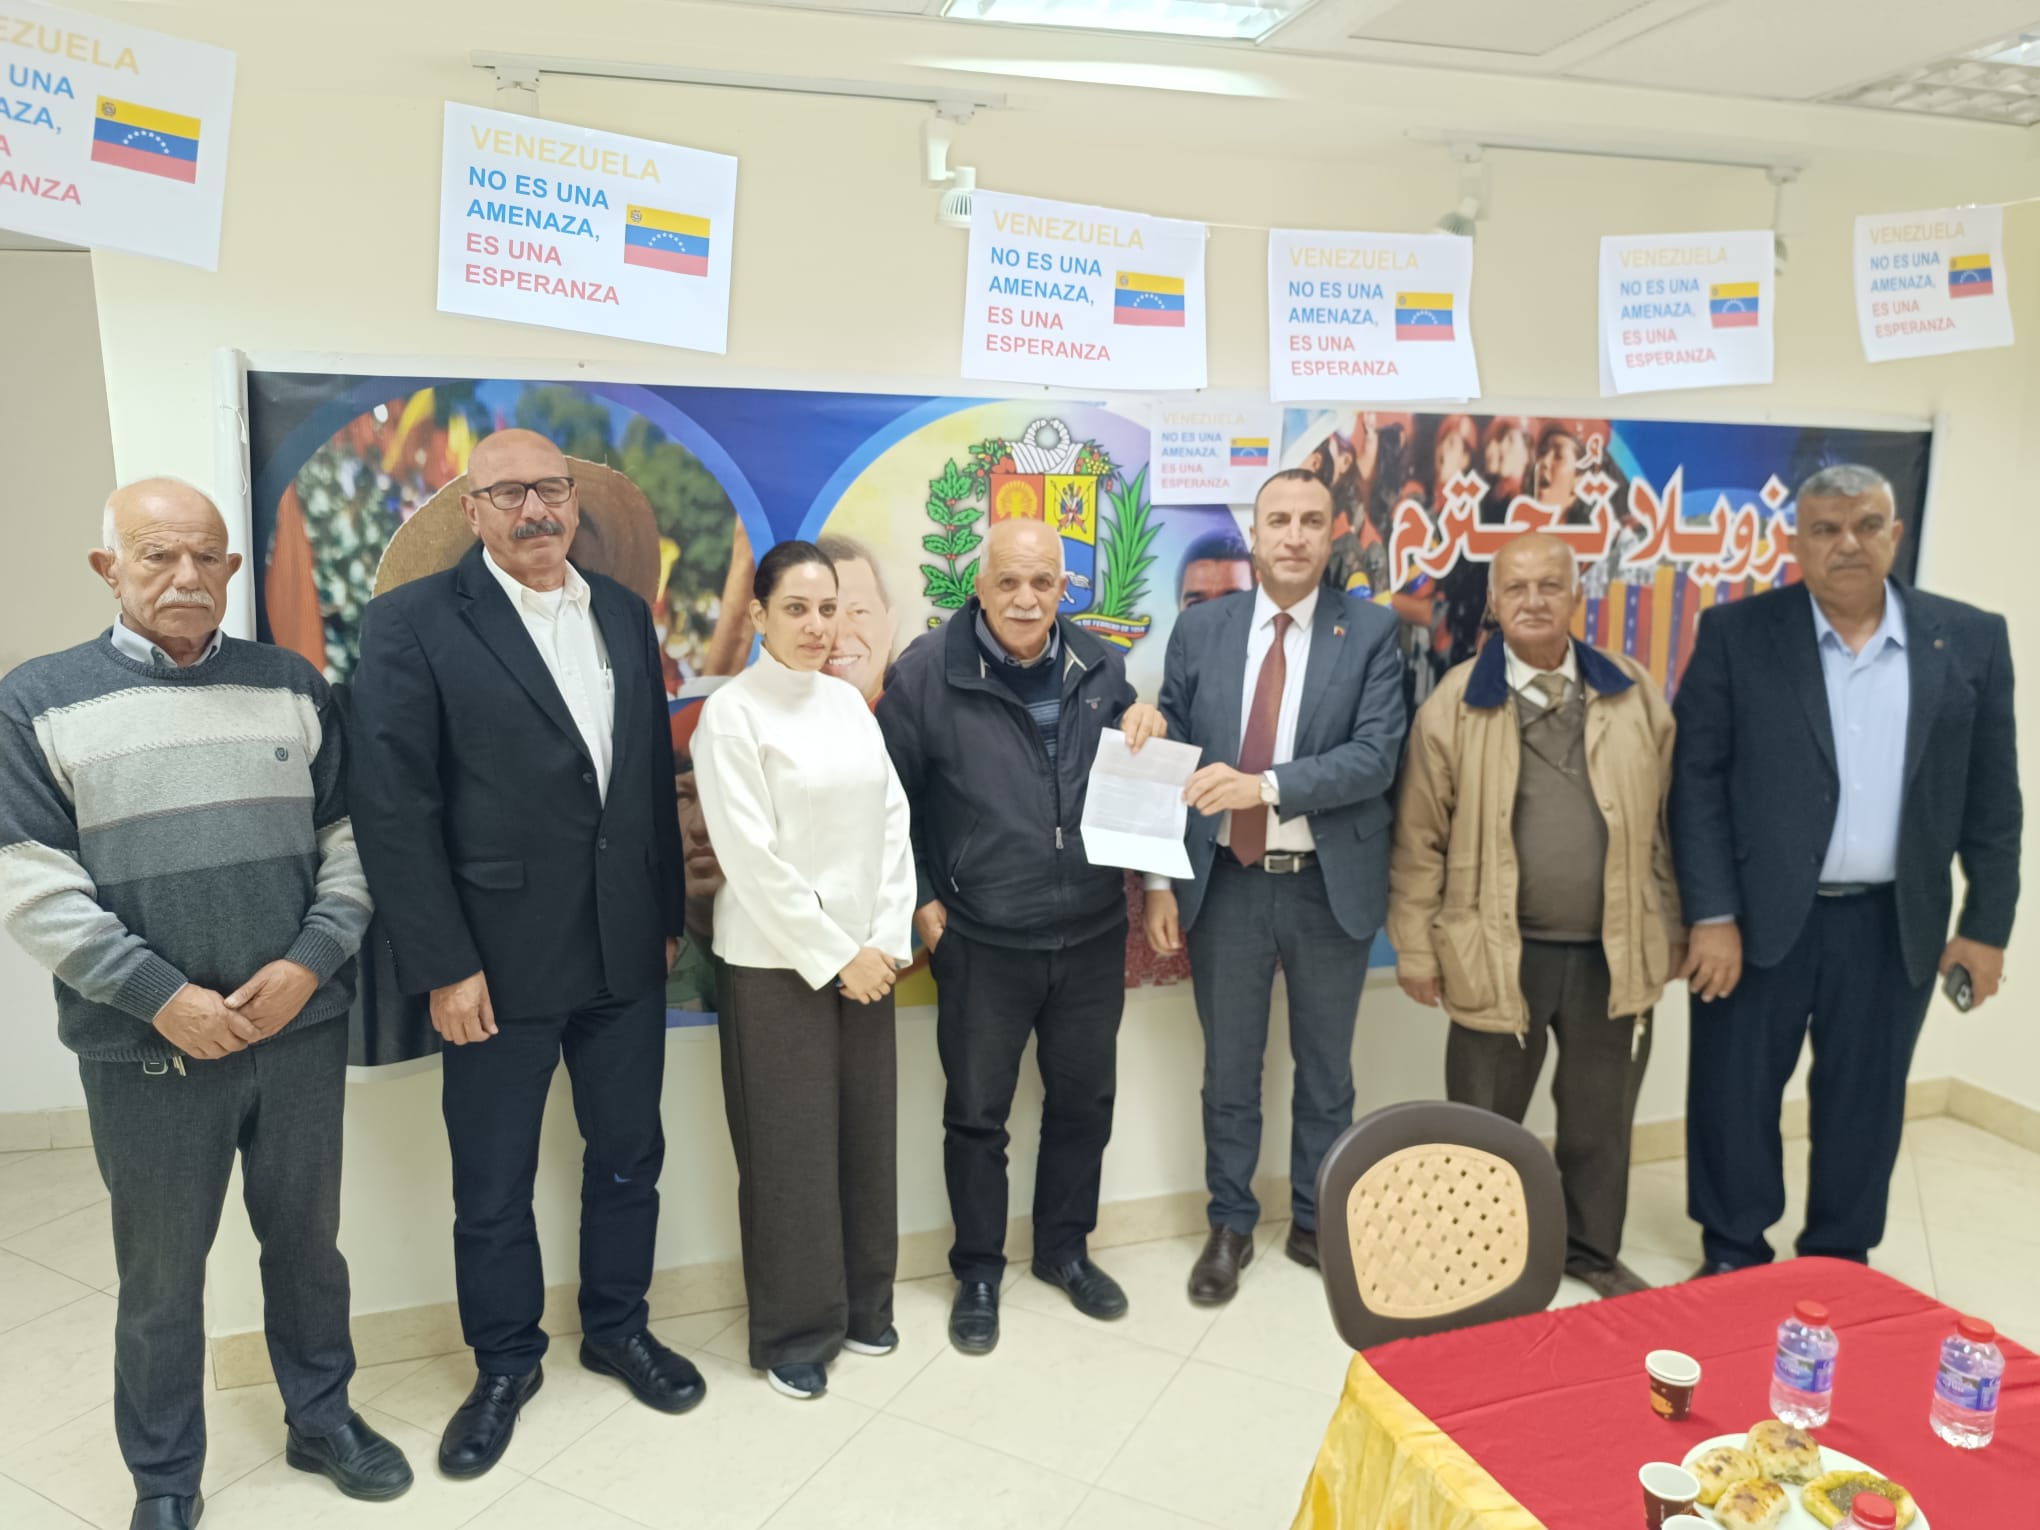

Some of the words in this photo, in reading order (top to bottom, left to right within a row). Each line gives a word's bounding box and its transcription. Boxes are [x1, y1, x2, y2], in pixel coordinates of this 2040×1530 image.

[9, 63, 74, 99] UNA
[471, 124, 661, 183] VENEZUELA
[469, 166, 507, 191] NO
[515, 174, 548, 198] ES
[556, 182, 609, 210] UNA
[466, 199, 600, 242] AMENAZA,
[993, 209, 1144, 250] VENEZUELA
[1870, 221, 1966, 245] VENEZUELA
[466, 232, 499, 255] ES
[508, 239, 562, 266] UNA
[1288, 247, 1419, 271] VENEZUELA
[1619, 245, 1728, 268] VENEZUELA
[991, 246, 1020, 267] NO
[1027, 251, 1053, 271] ES
[1059, 255, 1102, 277] UNA
[1870, 255, 1890, 270] NO
[1893, 253, 1909, 269] ES
[1912, 251, 1940, 267] UNA
[465, 263, 620, 305] ESPERANZA
[988, 275, 1095, 307] AMENAZA,
[1288, 281, 1314, 298] NO
[1320, 282, 1342, 298] ES
[1347, 283, 1384, 300] UNA
[1620, 280, 1642, 296] NO
[1646, 279, 1665, 295] ES
[1669, 277, 1700, 294] UNA
[1871, 275, 1936, 293] AMENAZA,
[987, 305, 1014, 325] ES
[1020, 310, 1063, 330] UNA
[1288, 307, 1379, 327] AMENAZA,
[1620, 302, 1696, 320] AMENAZA,
[1872, 301, 1889, 317] ES
[1892, 300, 1920, 315] UNA
[1622, 329, 1642, 346] ES
[1646, 327, 1677, 344] UNA
[1875, 317, 1955, 338] ESPERANZA
[986, 334, 1111, 362] ESPERANZA
[1289, 335, 1312, 351] ES
[1318, 335, 1355, 352] UNA
[1291, 360, 1399, 376] ESPERANZA
[1625, 348, 1716, 368] ESPERANZA
[1161, 432, 1178, 442] NO
[1181, 432, 1195, 442] ES
[1199, 432, 1222, 443] UNA
[1161, 463, 1177, 474] ES
[1179, 463, 1203, 474] UNA
[1161, 478, 1230, 489] ESPERANZA
[1620, 463, 1797, 586] زويلا
